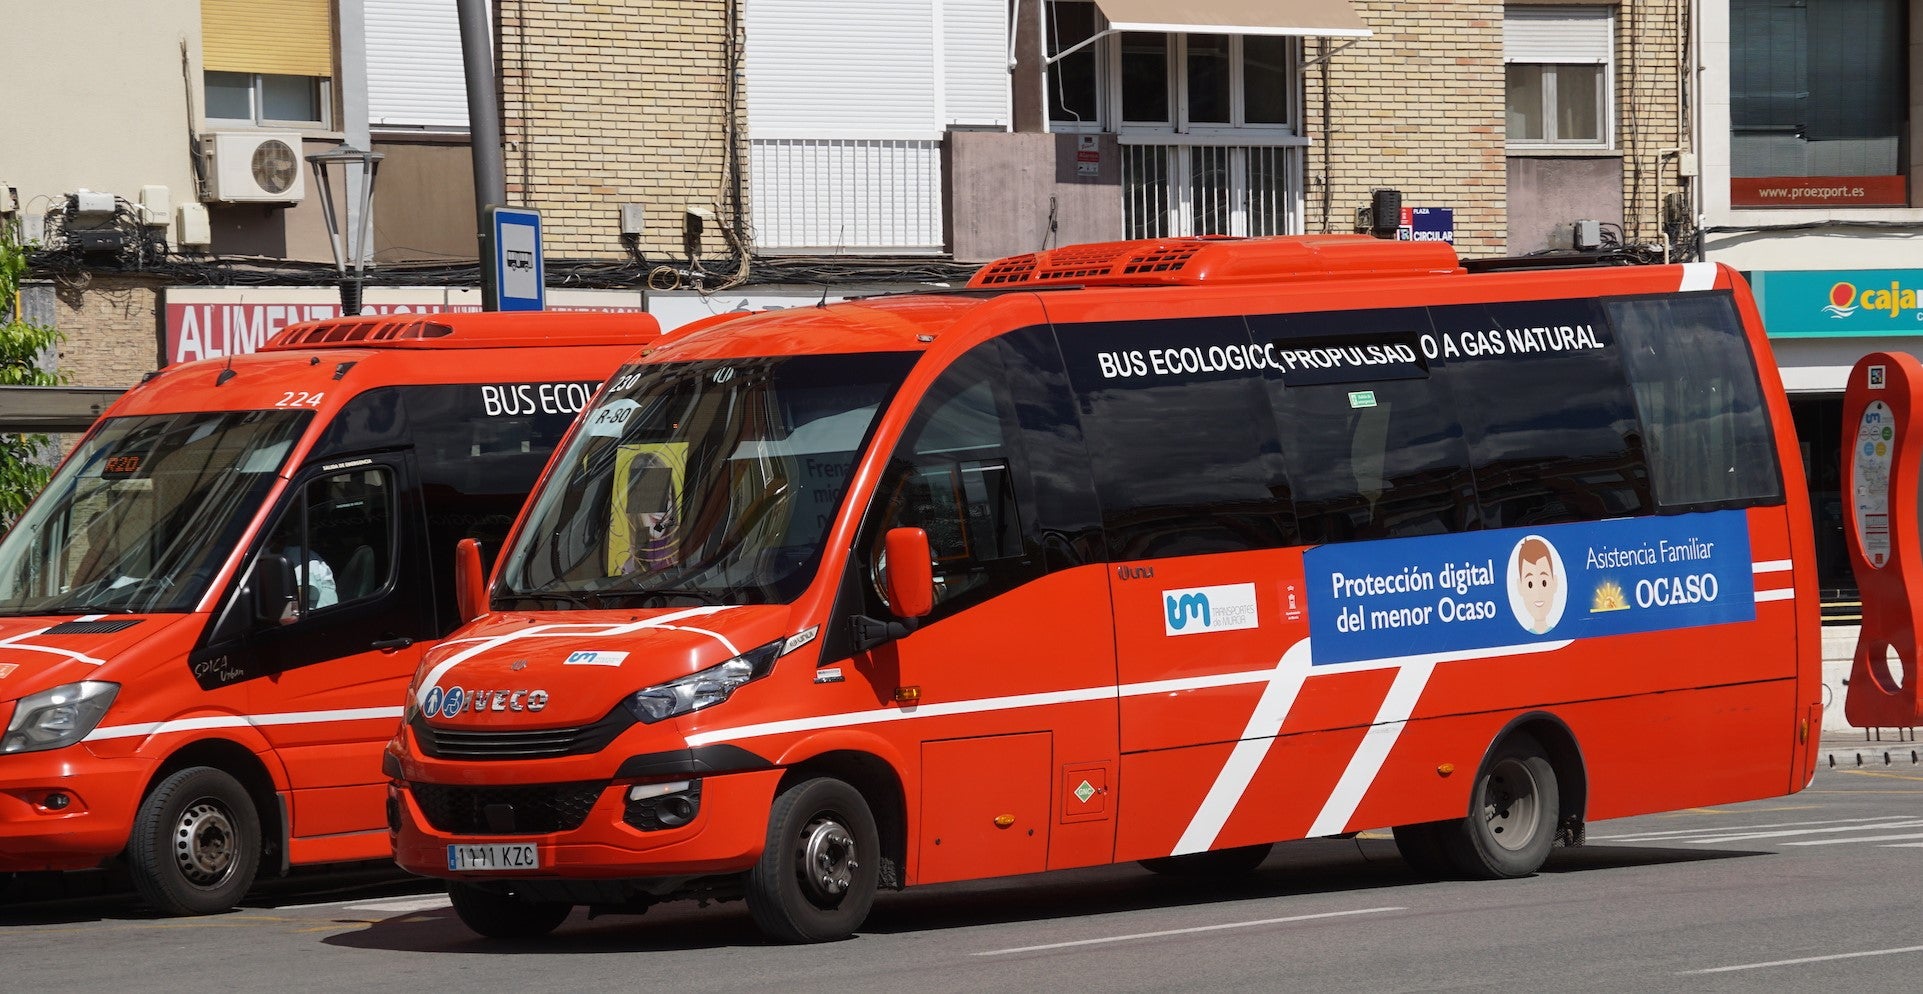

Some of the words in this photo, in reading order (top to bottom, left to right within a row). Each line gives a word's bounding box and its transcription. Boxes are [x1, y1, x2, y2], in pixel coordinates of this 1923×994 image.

[1759, 186, 1865, 199] www.proexport.es
[1413, 231, 1453, 242] CIRCULAR
[1097, 350, 1148, 379] BUS
[1443, 333, 1461, 358] A
[1460, 329, 1506, 357] GAS
[1505, 324, 1605, 354] NATURAL
[608, 372, 642, 393] 230
[275, 391, 325, 407] 224
[481, 384, 537, 416] BUS
[595, 407, 632, 425] R-80
[1586, 542, 1657, 570] Asistencia
[1659, 537, 1715, 563] Familiar
[1331, 565, 1435, 599] Protección
[1438, 559, 1495, 595] digital
[1635, 572, 1719, 609] OCASO
[1211, 604, 1255, 618] TRANSPORTES
[1336, 604, 1366, 633] del
[1371, 606, 1433, 630] menor
[1437, 596, 1497, 623] Ocaso
[194, 655, 228, 679] SPICA
[462, 688, 549, 713] IVECO
[502, 846, 534, 866] KZC
